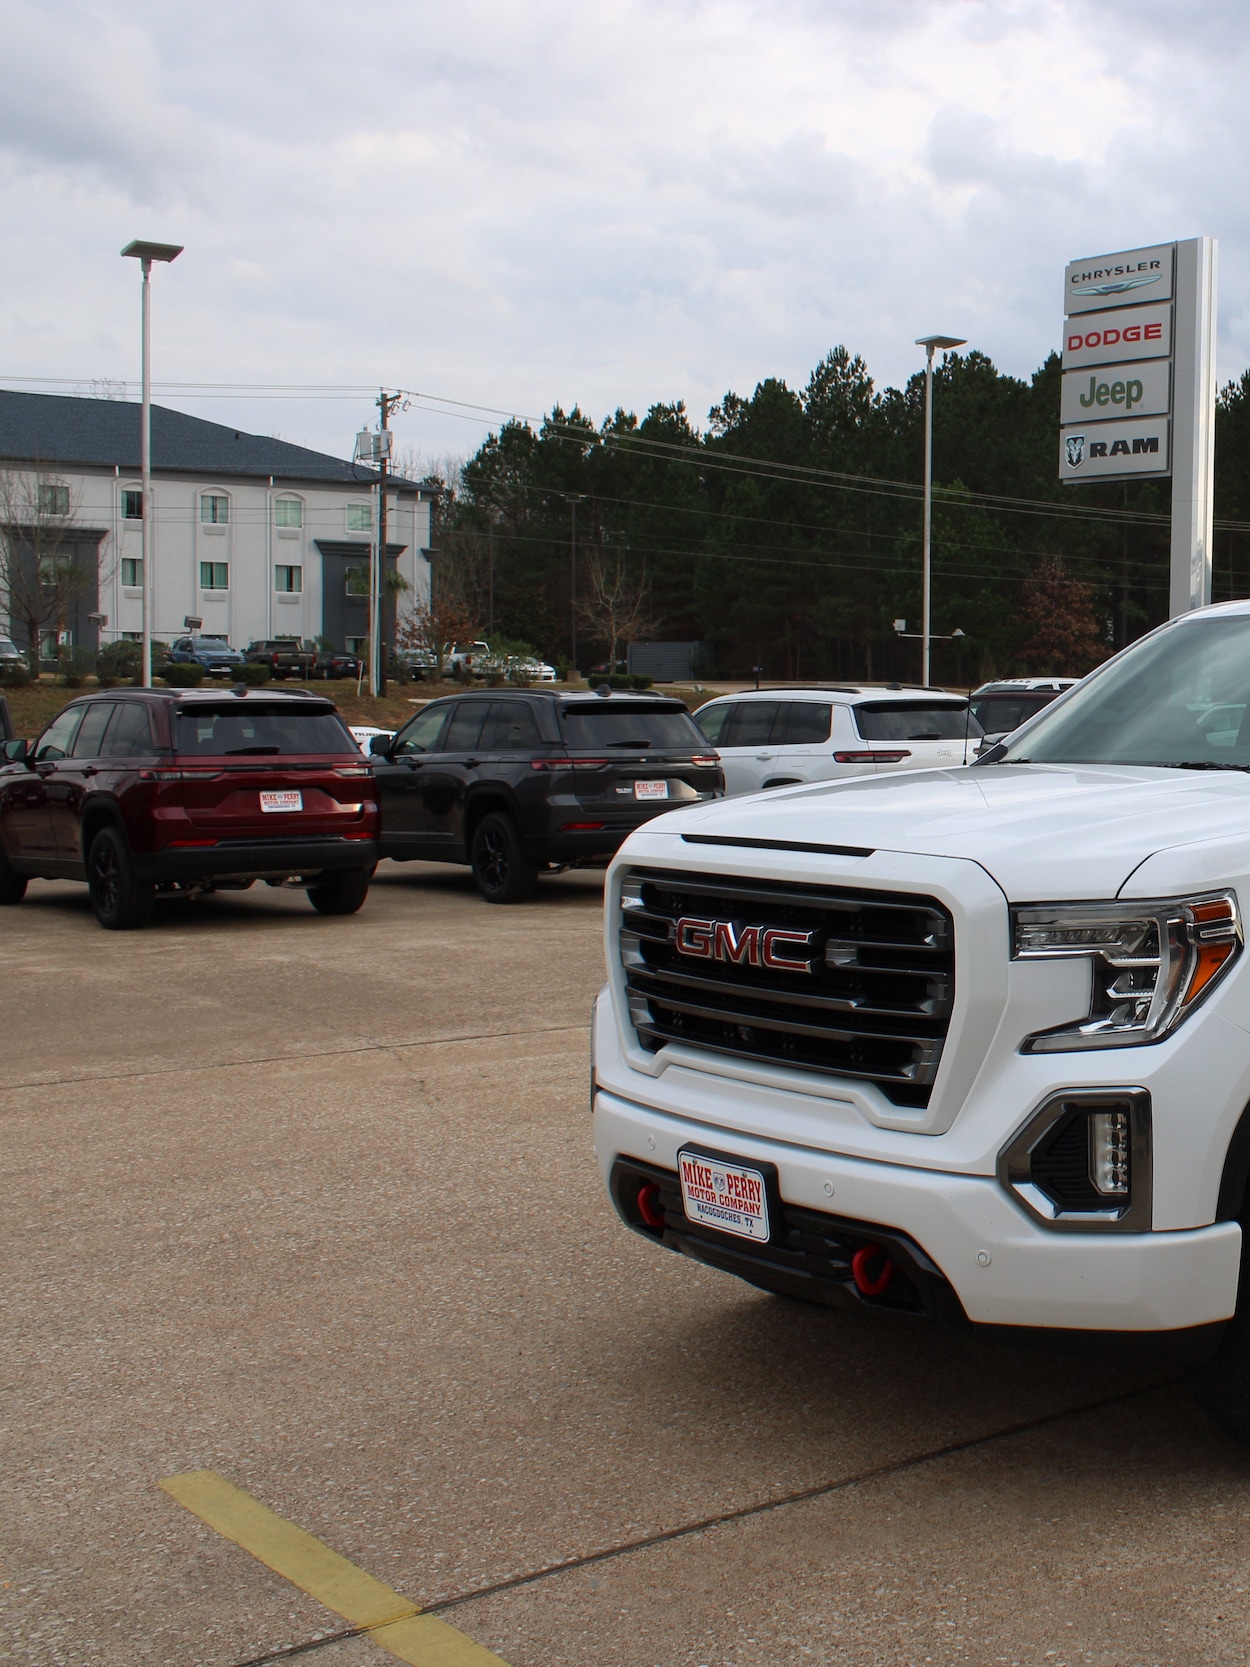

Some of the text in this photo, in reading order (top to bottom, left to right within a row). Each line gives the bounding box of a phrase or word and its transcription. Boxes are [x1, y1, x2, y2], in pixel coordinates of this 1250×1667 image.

[1071, 260, 1161, 284] CHRYSLER
[1068, 323, 1163, 352] DODGE
[1080, 376, 1143, 410] Jeep
[1089, 437, 1159, 459] RAM
[262, 793, 299, 801] MIKE PERRY
[676, 917, 813, 974] GMC
[683, 1161, 761, 1203] MIKE PERRY
[687, 1184, 761, 1216] MOTOR COMPANY
[745, 1217, 754, 1228] TX
